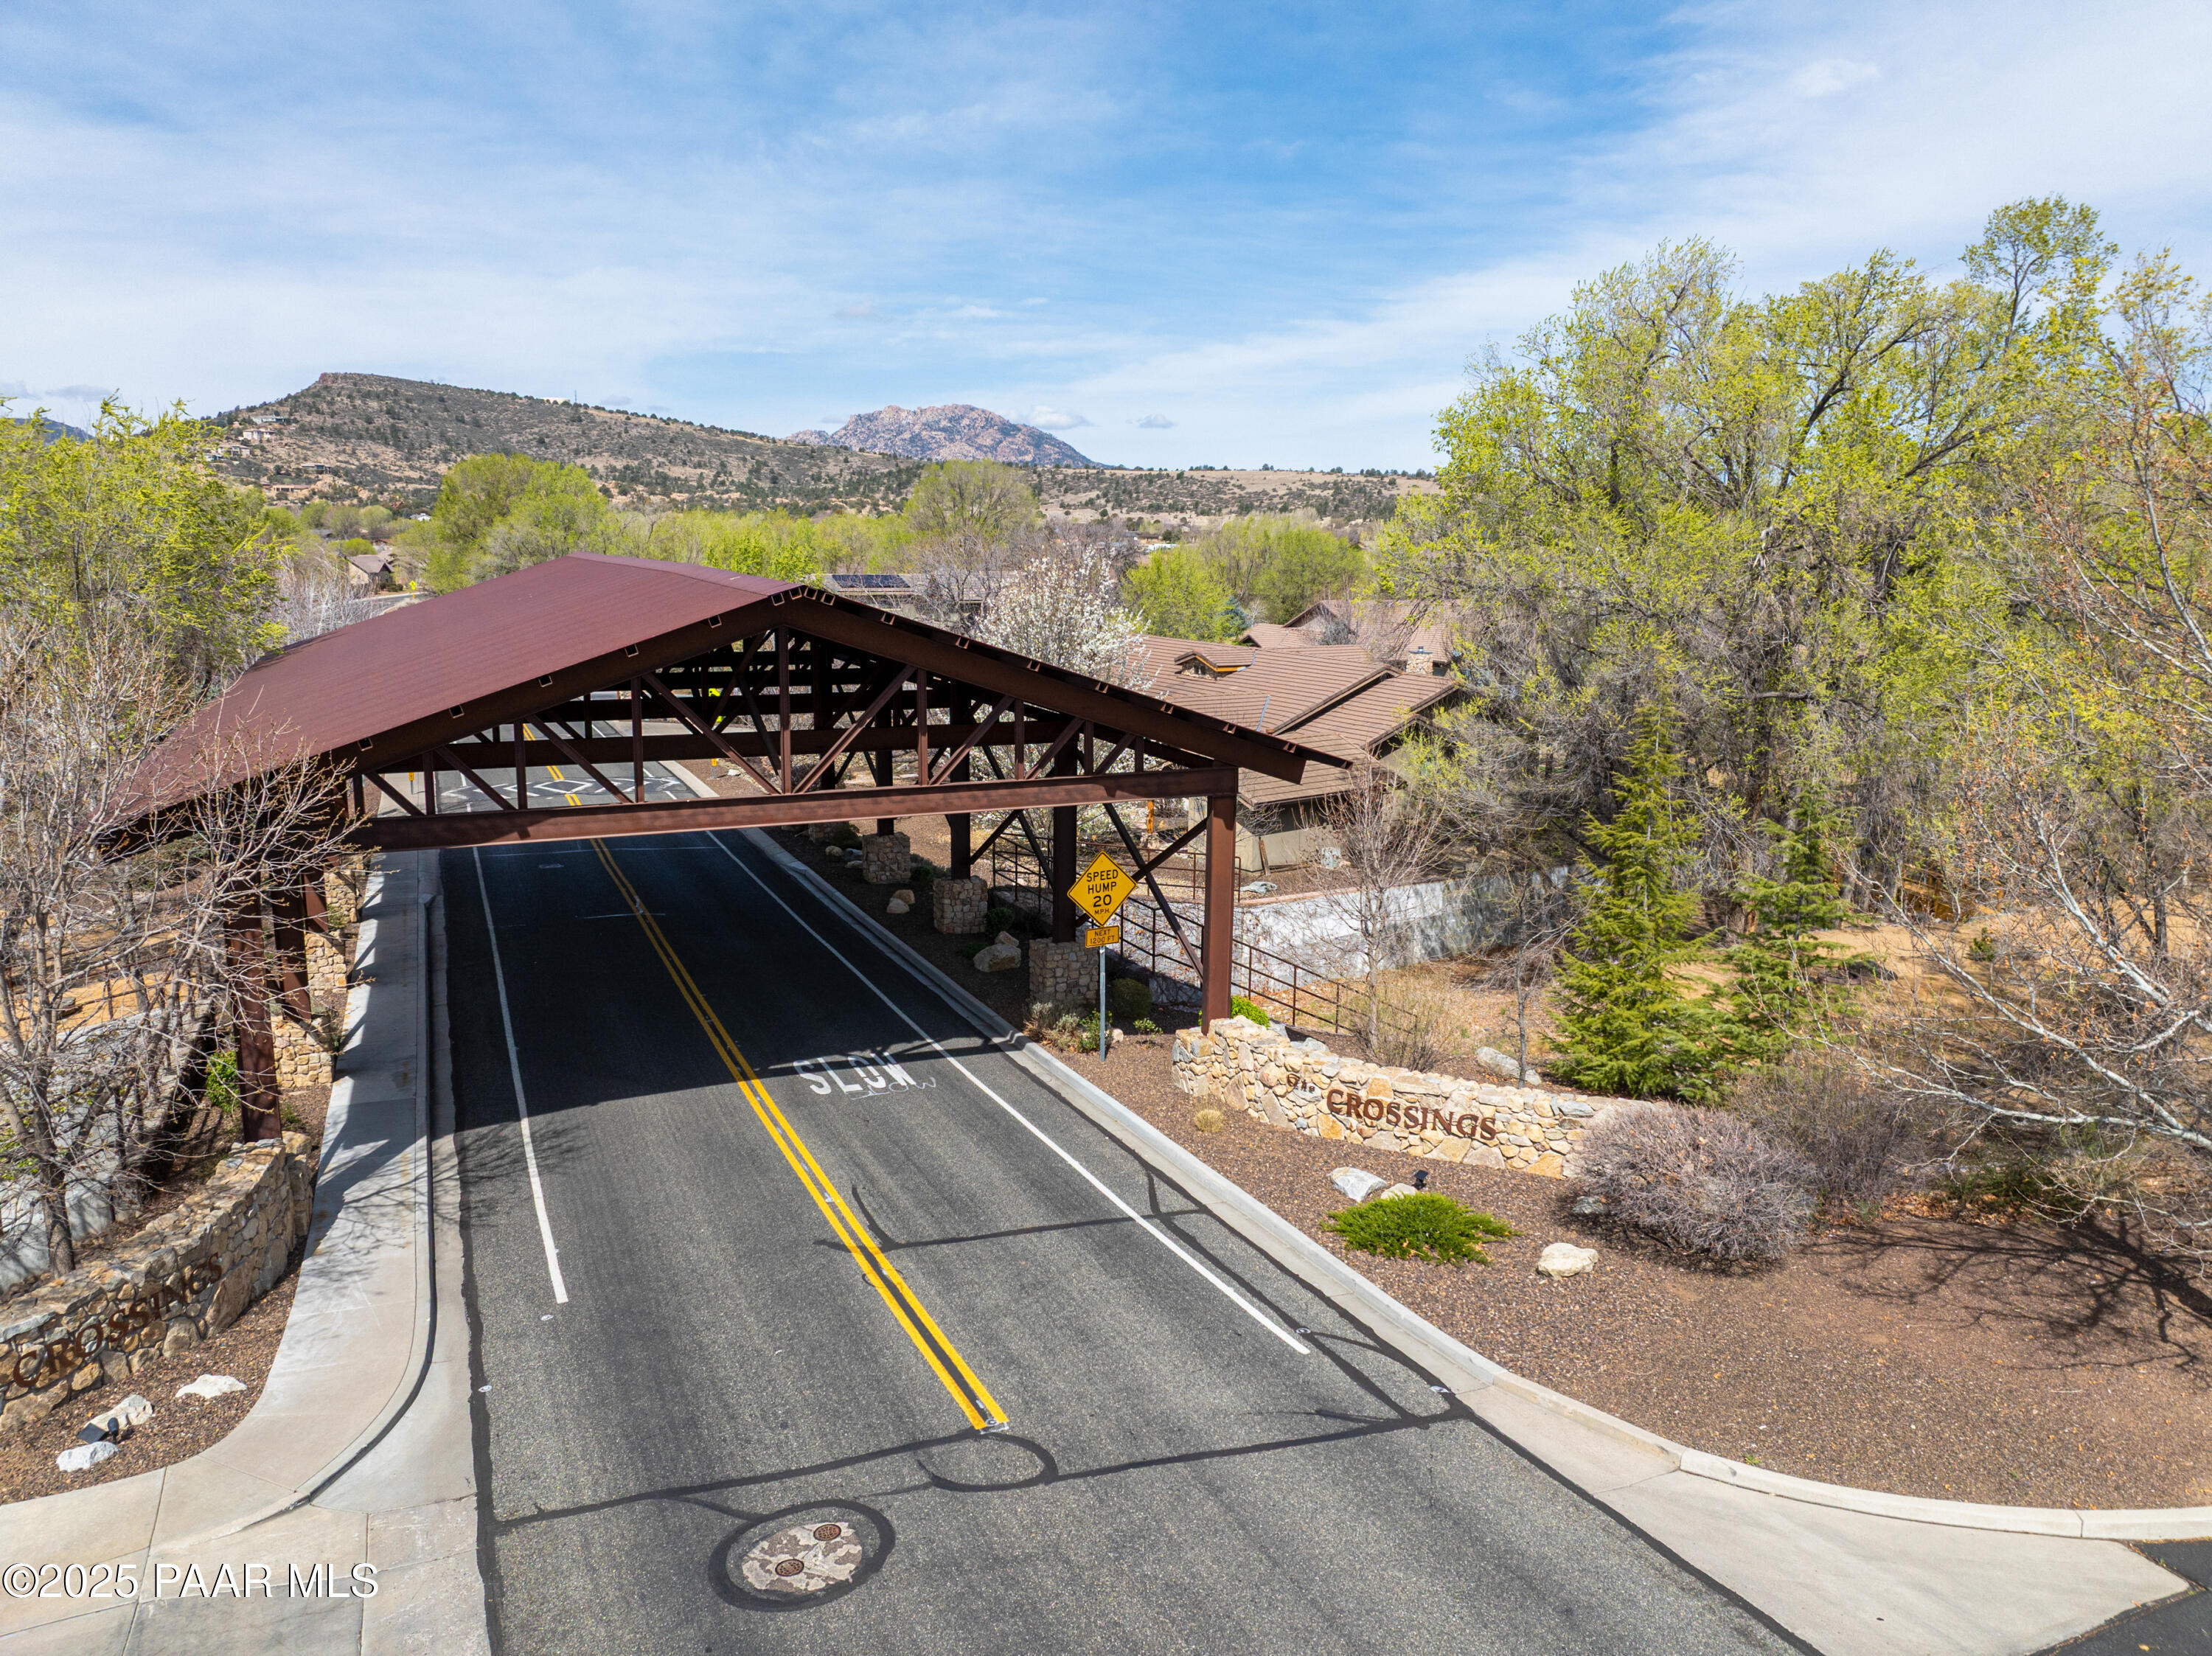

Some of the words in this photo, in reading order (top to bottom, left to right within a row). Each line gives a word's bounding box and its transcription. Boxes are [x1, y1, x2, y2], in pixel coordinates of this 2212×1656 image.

[1086, 869, 1119, 882] SPEED
[1088, 881, 1117, 894] HUMP
[1093, 894, 1112, 908] 20
[1094, 929, 1110, 937] NEXT
[1090, 936, 1105, 944] 1200
[793, 1051, 917, 1095] SLOW
[1326, 1088, 1497, 1141] CROSSINGS
[12, 1252, 223, 1388] CROSSINGS
